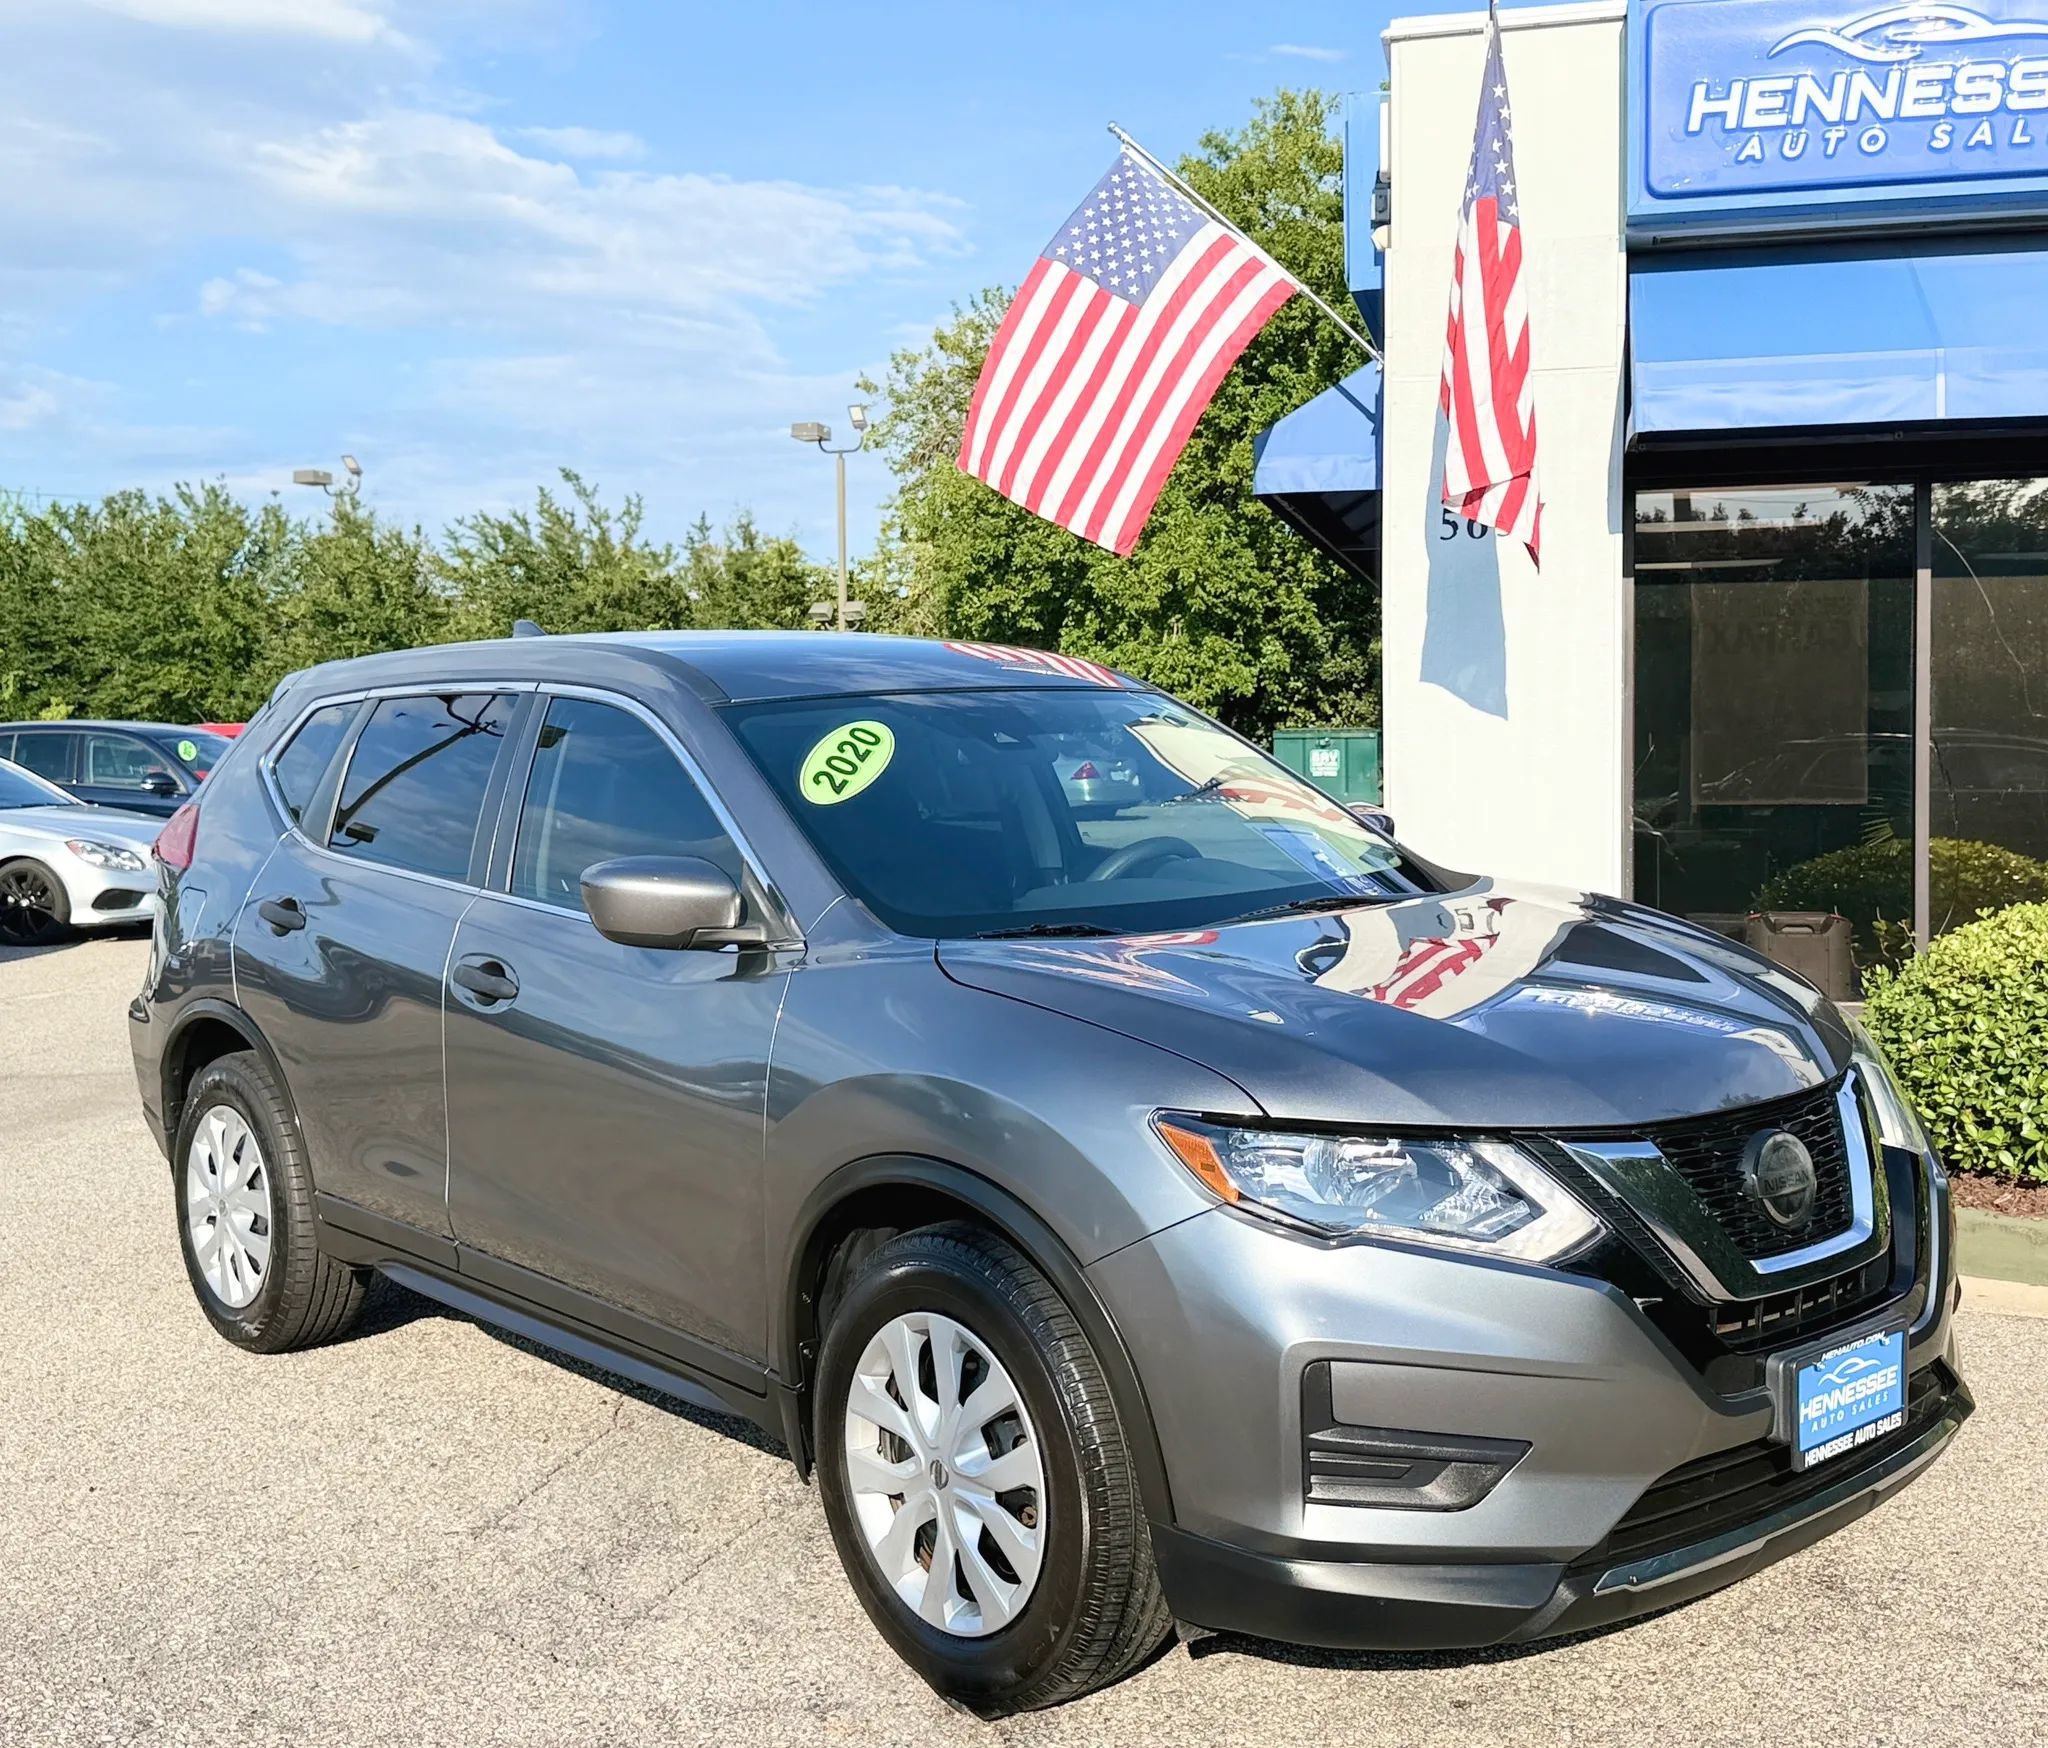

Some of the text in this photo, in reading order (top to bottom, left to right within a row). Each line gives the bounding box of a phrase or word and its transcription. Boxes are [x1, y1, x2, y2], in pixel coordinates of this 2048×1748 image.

[1737, 129, 1887, 162] AUTO
[812, 727, 881, 795] 2020
[1763, 1170, 1809, 1192] NISSAN
[1800, 1365, 1898, 1424] HENNESSEE
[1811, 1393, 1889, 1433] AUTO SALES
[1804, 1411, 1903, 1468] HENNESSEE AUTO SALES
